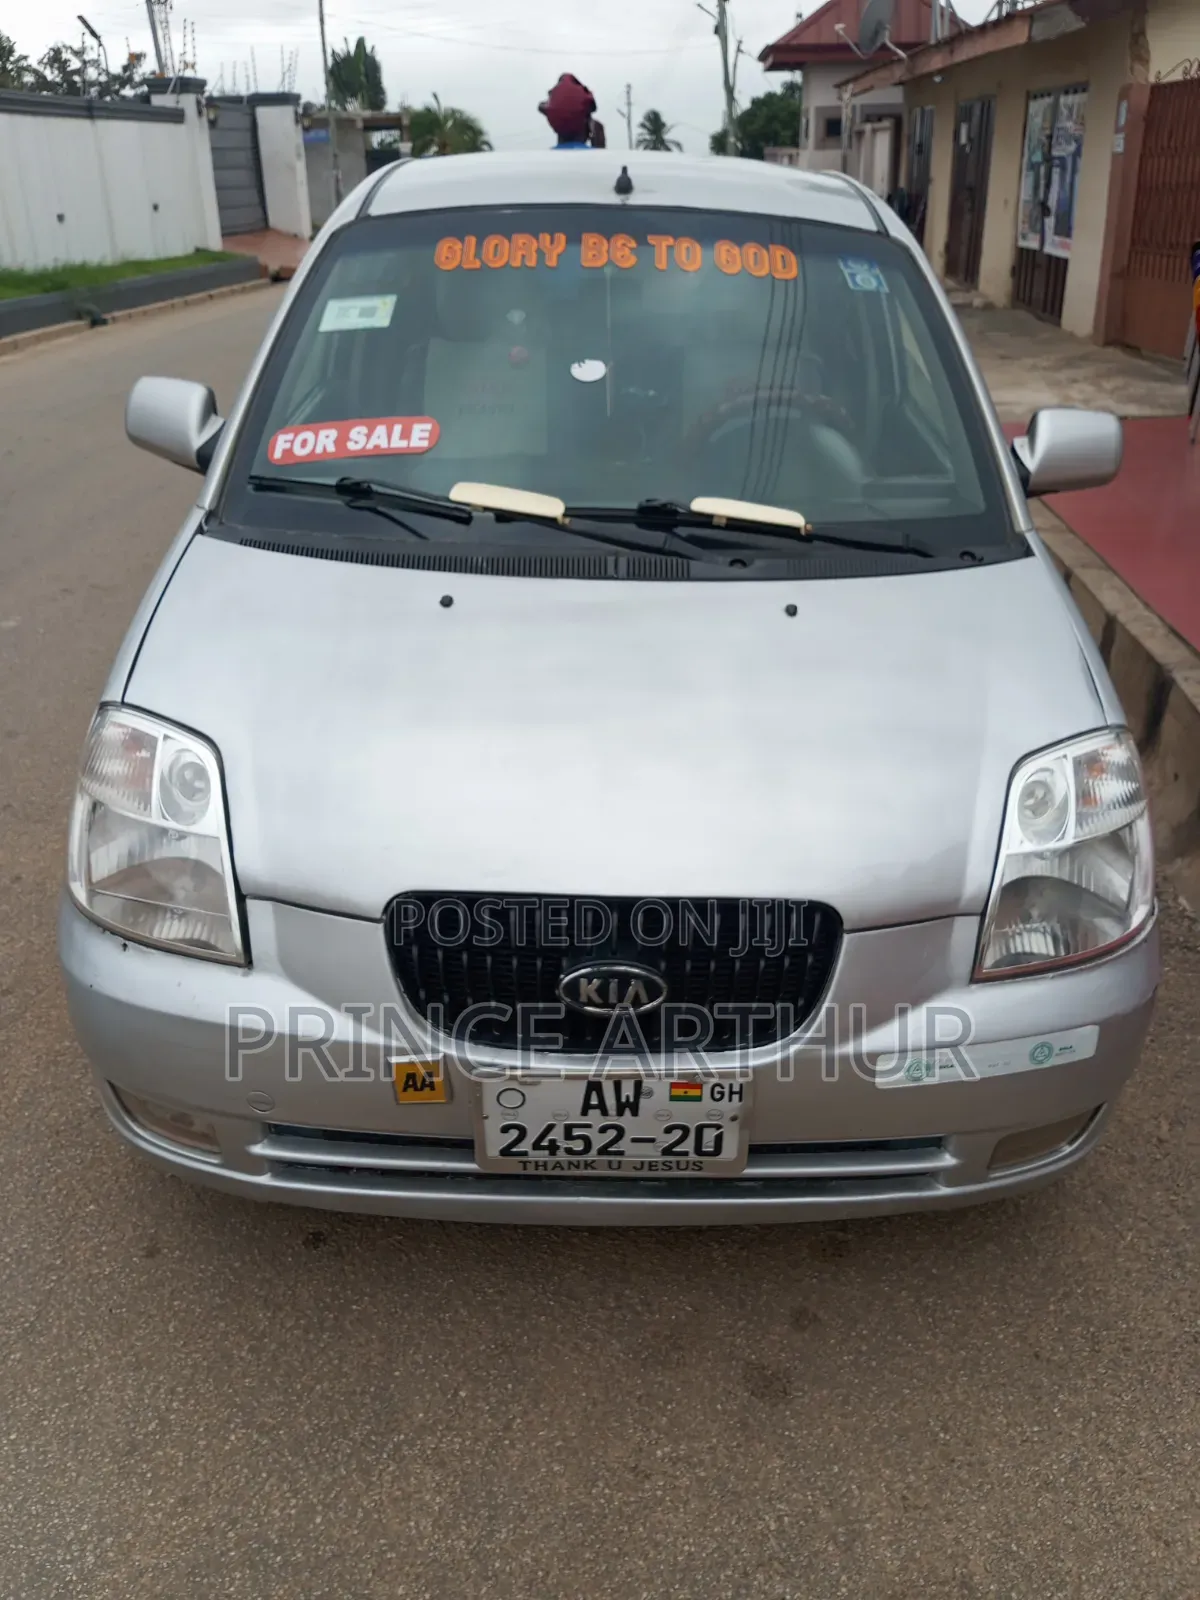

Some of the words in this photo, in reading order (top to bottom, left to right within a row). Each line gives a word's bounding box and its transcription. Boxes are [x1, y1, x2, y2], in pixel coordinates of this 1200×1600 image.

[434, 232, 567, 271] GLORY
[580, 232, 638, 270] BE
[647, 234, 702, 272] TO
[714, 239, 798, 281] GOD
[273, 428, 338, 460] FOR
[346, 423, 433, 451] SALE
[578, 977, 650, 1005] KIA
[402, 1072, 436, 1093] AA
[710, 1082, 744, 1103] GH
[580, 1080, 643, 1117] AW
[499, 1122, 724, 1157] 2452-20
[518, 1160, 596, 1172] THANK
[608, 1160, 622, 1171] U
[632, 1160, 704, 1172] JESUS
